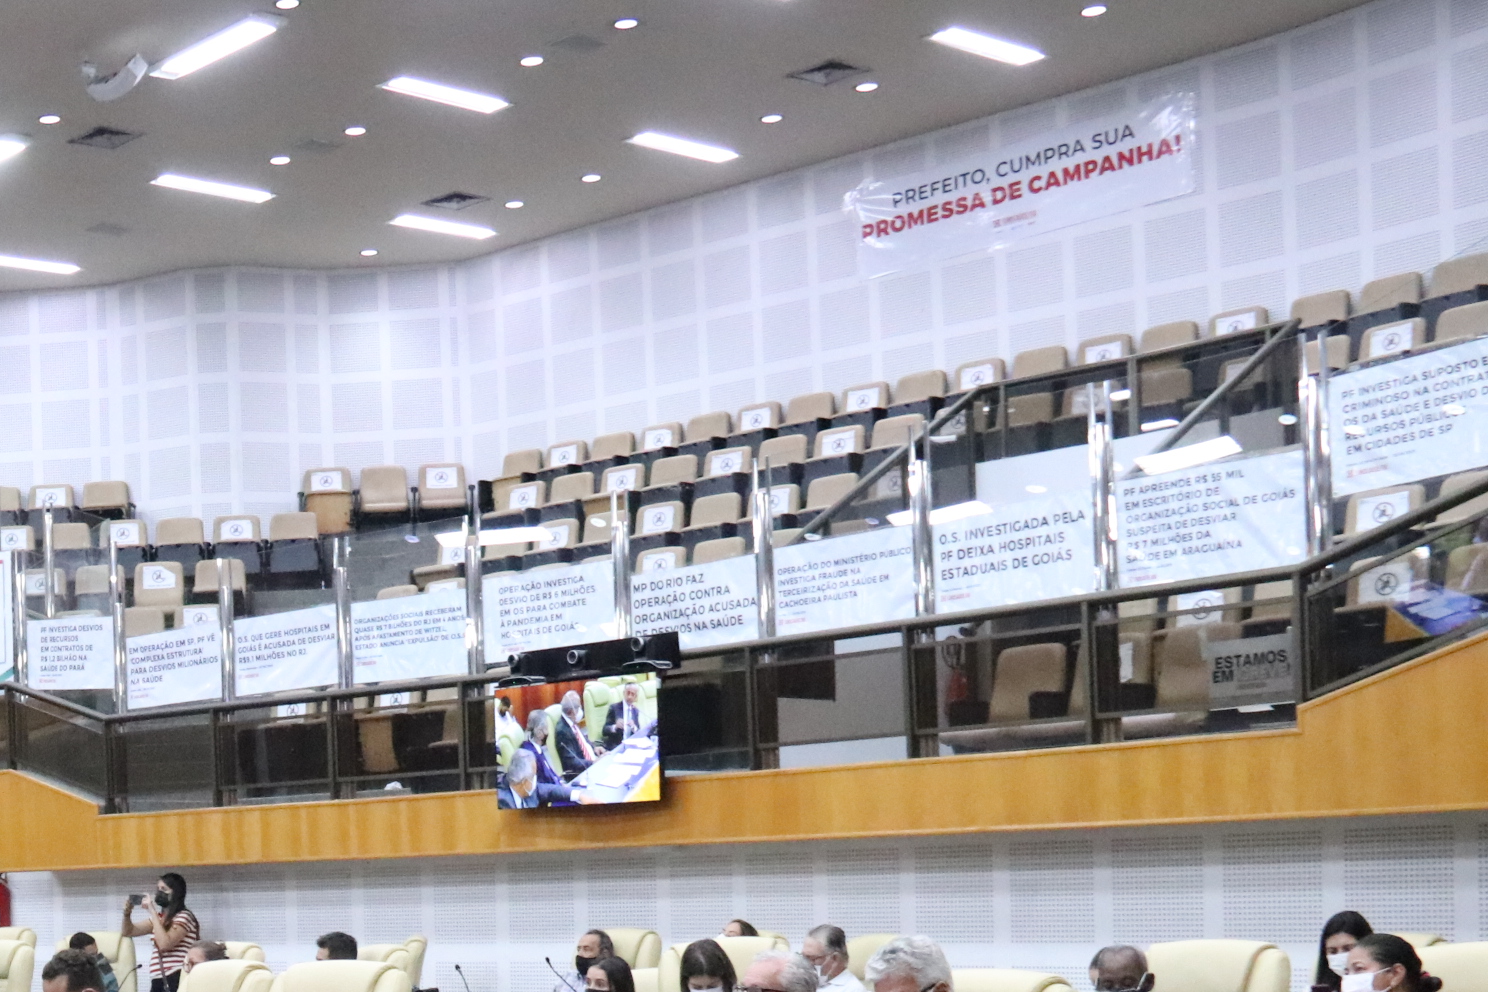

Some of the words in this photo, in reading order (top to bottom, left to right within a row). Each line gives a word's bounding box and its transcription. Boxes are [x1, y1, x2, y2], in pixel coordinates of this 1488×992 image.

[893, 167, 991, 208] PREFEITO,
[995, 139, 1086, 178] CUMPRA
[1091, 124, 1135, 149] SUA
[862, 191, 986, 239] PROMESSA
[991, 180, 1023, 206] DE
[1028, 133, 1183, 195] CAMPANHA!
[1342, 391, 1354, 399] PF
[1358, 375, 1418, 396] INVESTIGA
[1421, 359, 1478, 381] SUPOSTO
[1342, 391, 1409, 414] CRIMINOSO
[1413, 386, 1429, 396] NA
[1362, 412, 1377, 423] DA
[1434, 388, 1477, 406] DESVIO
[1346, 444, 1362, 455] EM
[1365, 432, 1416, 451] CIDADES
[1419, 427, 1434, 439] DE
[1439, 424, 1453, 434] SP
[1124, 487, 1135, 497] PF
[1139, 478, 1191, 495] APREENDE
[1195, 474, 1207, 485] R$
[1225, 470, 1244, 480] MIL
[1125, 500, 1139, 511] EM
[1206, 487, 1220, 497] DE
[1203, 499, 1240, 511] SOCIAL
[1243, 495, 1258, 505] DE
[940, 532, 961, 545] O.S.
[965, 516, 1049, 541] INVESTIGADA
[1053, 510, 1085, 525] PELA
[1127, 523, 1172, 538] SUSPEITA
[1176, 520, 1188, 530] DE
[1191, 512, 1237, 527] DESVIAR
[1197, 530, 1211, 540] DA
[941, 551, 953, 563] PF
[957, 544, 994, 560] DEIXA
[998, 532, 1065, 554] HOSPITAIS
[1163, 549, 1177, 558] EM
[821, 560, 832, 569] DO
[942, 559, 1008, 581] ESTADUAIS
[1012, 556, 1028, 569] DE
[1032, 547, 1072, 566] GOIÁS
[544, 576, 584, 588] INVESTIGA
[634, 583, 647, 594] MP
[650, 581, 663, 592] DO
[667, 577, 682, 589] RIO
[686, 573, 705, 585] FAZ
[778, 574, 816, 587] INVESTIGA
[818, 570, 847, 581] FRAUDE
[850, 567, 861, 576] NA
[840, 580, 849, 588] DA
[879, 574, 889, 582] EM
[499, 595, 527, 606] DESVIO
[530, 594, 540, 602] DE
[543, 592, 552, 600] R$
[526, 605, 547, 613] PARA
[549, 598, 586, 610] COMBATE
[634, 592, 686, 609] OPERAÇÃO
[689, 585, 730, 601] CONTRA
[779, 596, 821, 609] CACHOEIRA
[824, 591, 858, 601] PAULISTA
[507, 615, 549, 626] PANDEMIA
[551, 613, 562, 621] EM
[635, 604, 705, 625] ORGANIZAÇÃO
[708, 597, 757, 613] ACUSADA
[49, 625, 77, 633] INVESTIGA
[78, 624, 103, 632] DESVIOS
[543, 625, 552, 634] DE
[695, 621, 708, 632] NA
[711, 614, 743, 629] SAÚDE
[251, 634, 264, 642] QUE
[265, 631, 282, 639] GERE
[284, 626, 318, 636] HOSPITAIS
[264, 640, 296, 650] ACUSADA
[308, 633, 335, 643] DESVIAR
[149, 664, 176, 673] DESVIOS
[1215, 650, 1287, 670] ESTAMOS
[1213, 670, 1234, 683] EM
